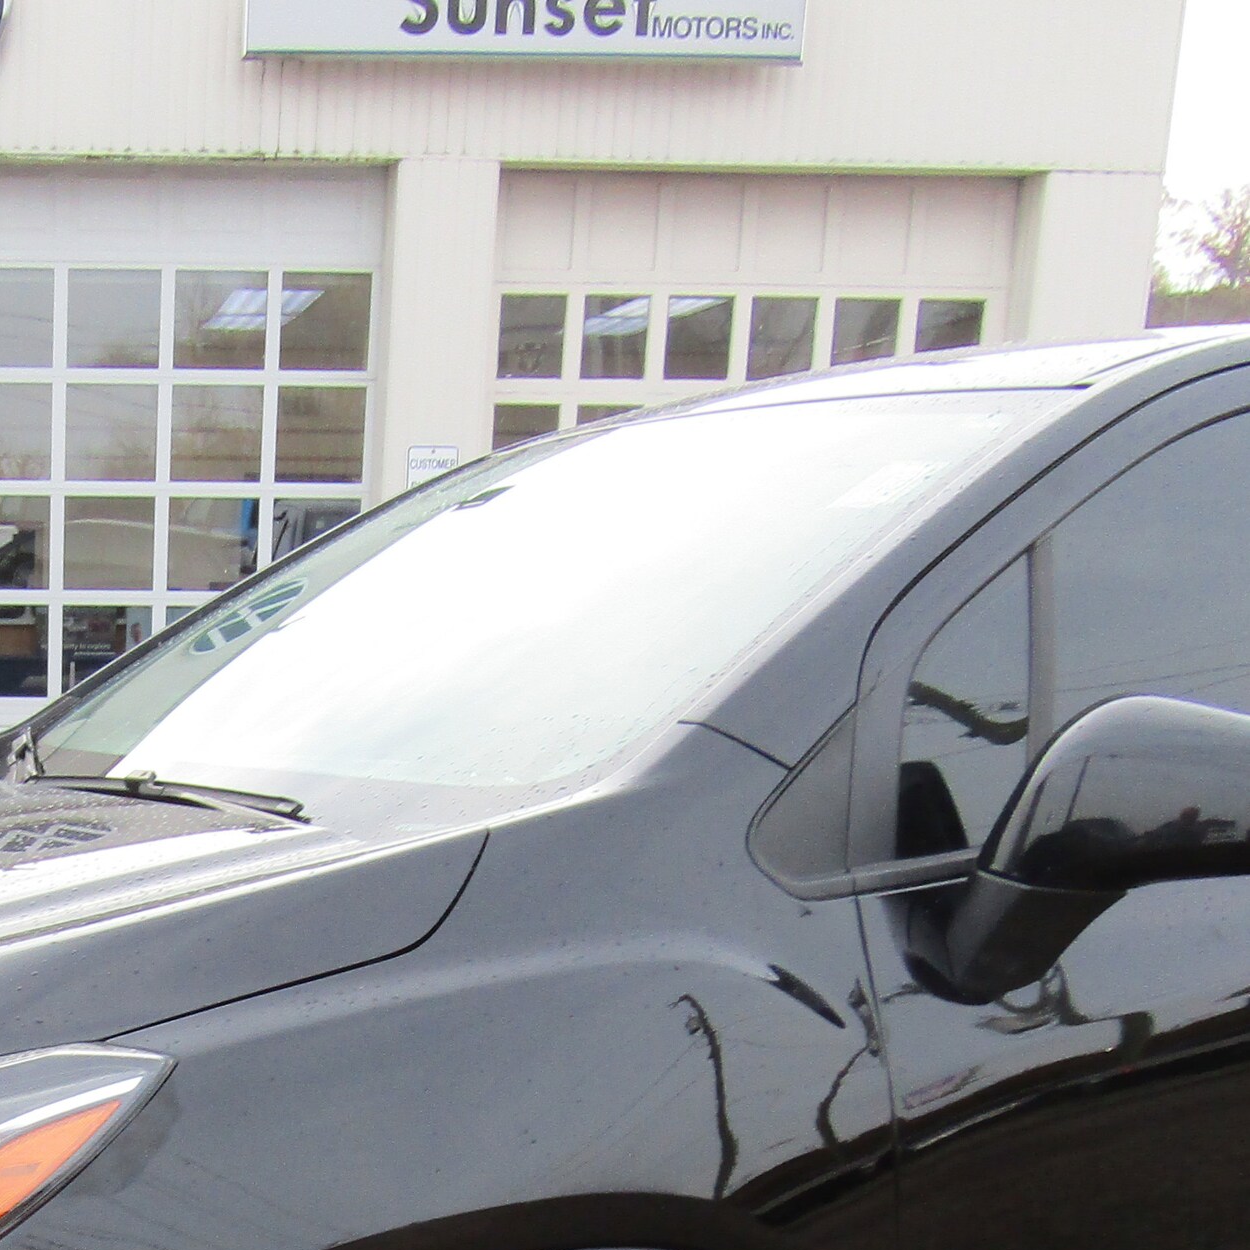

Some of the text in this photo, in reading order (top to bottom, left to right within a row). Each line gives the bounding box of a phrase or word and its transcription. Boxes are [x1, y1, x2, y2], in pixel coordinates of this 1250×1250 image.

[652, 16, 758, 40] MOTORS
[762, 23, 795, 40] INC.
[410, 458, 456, 470] CUSTOMER
